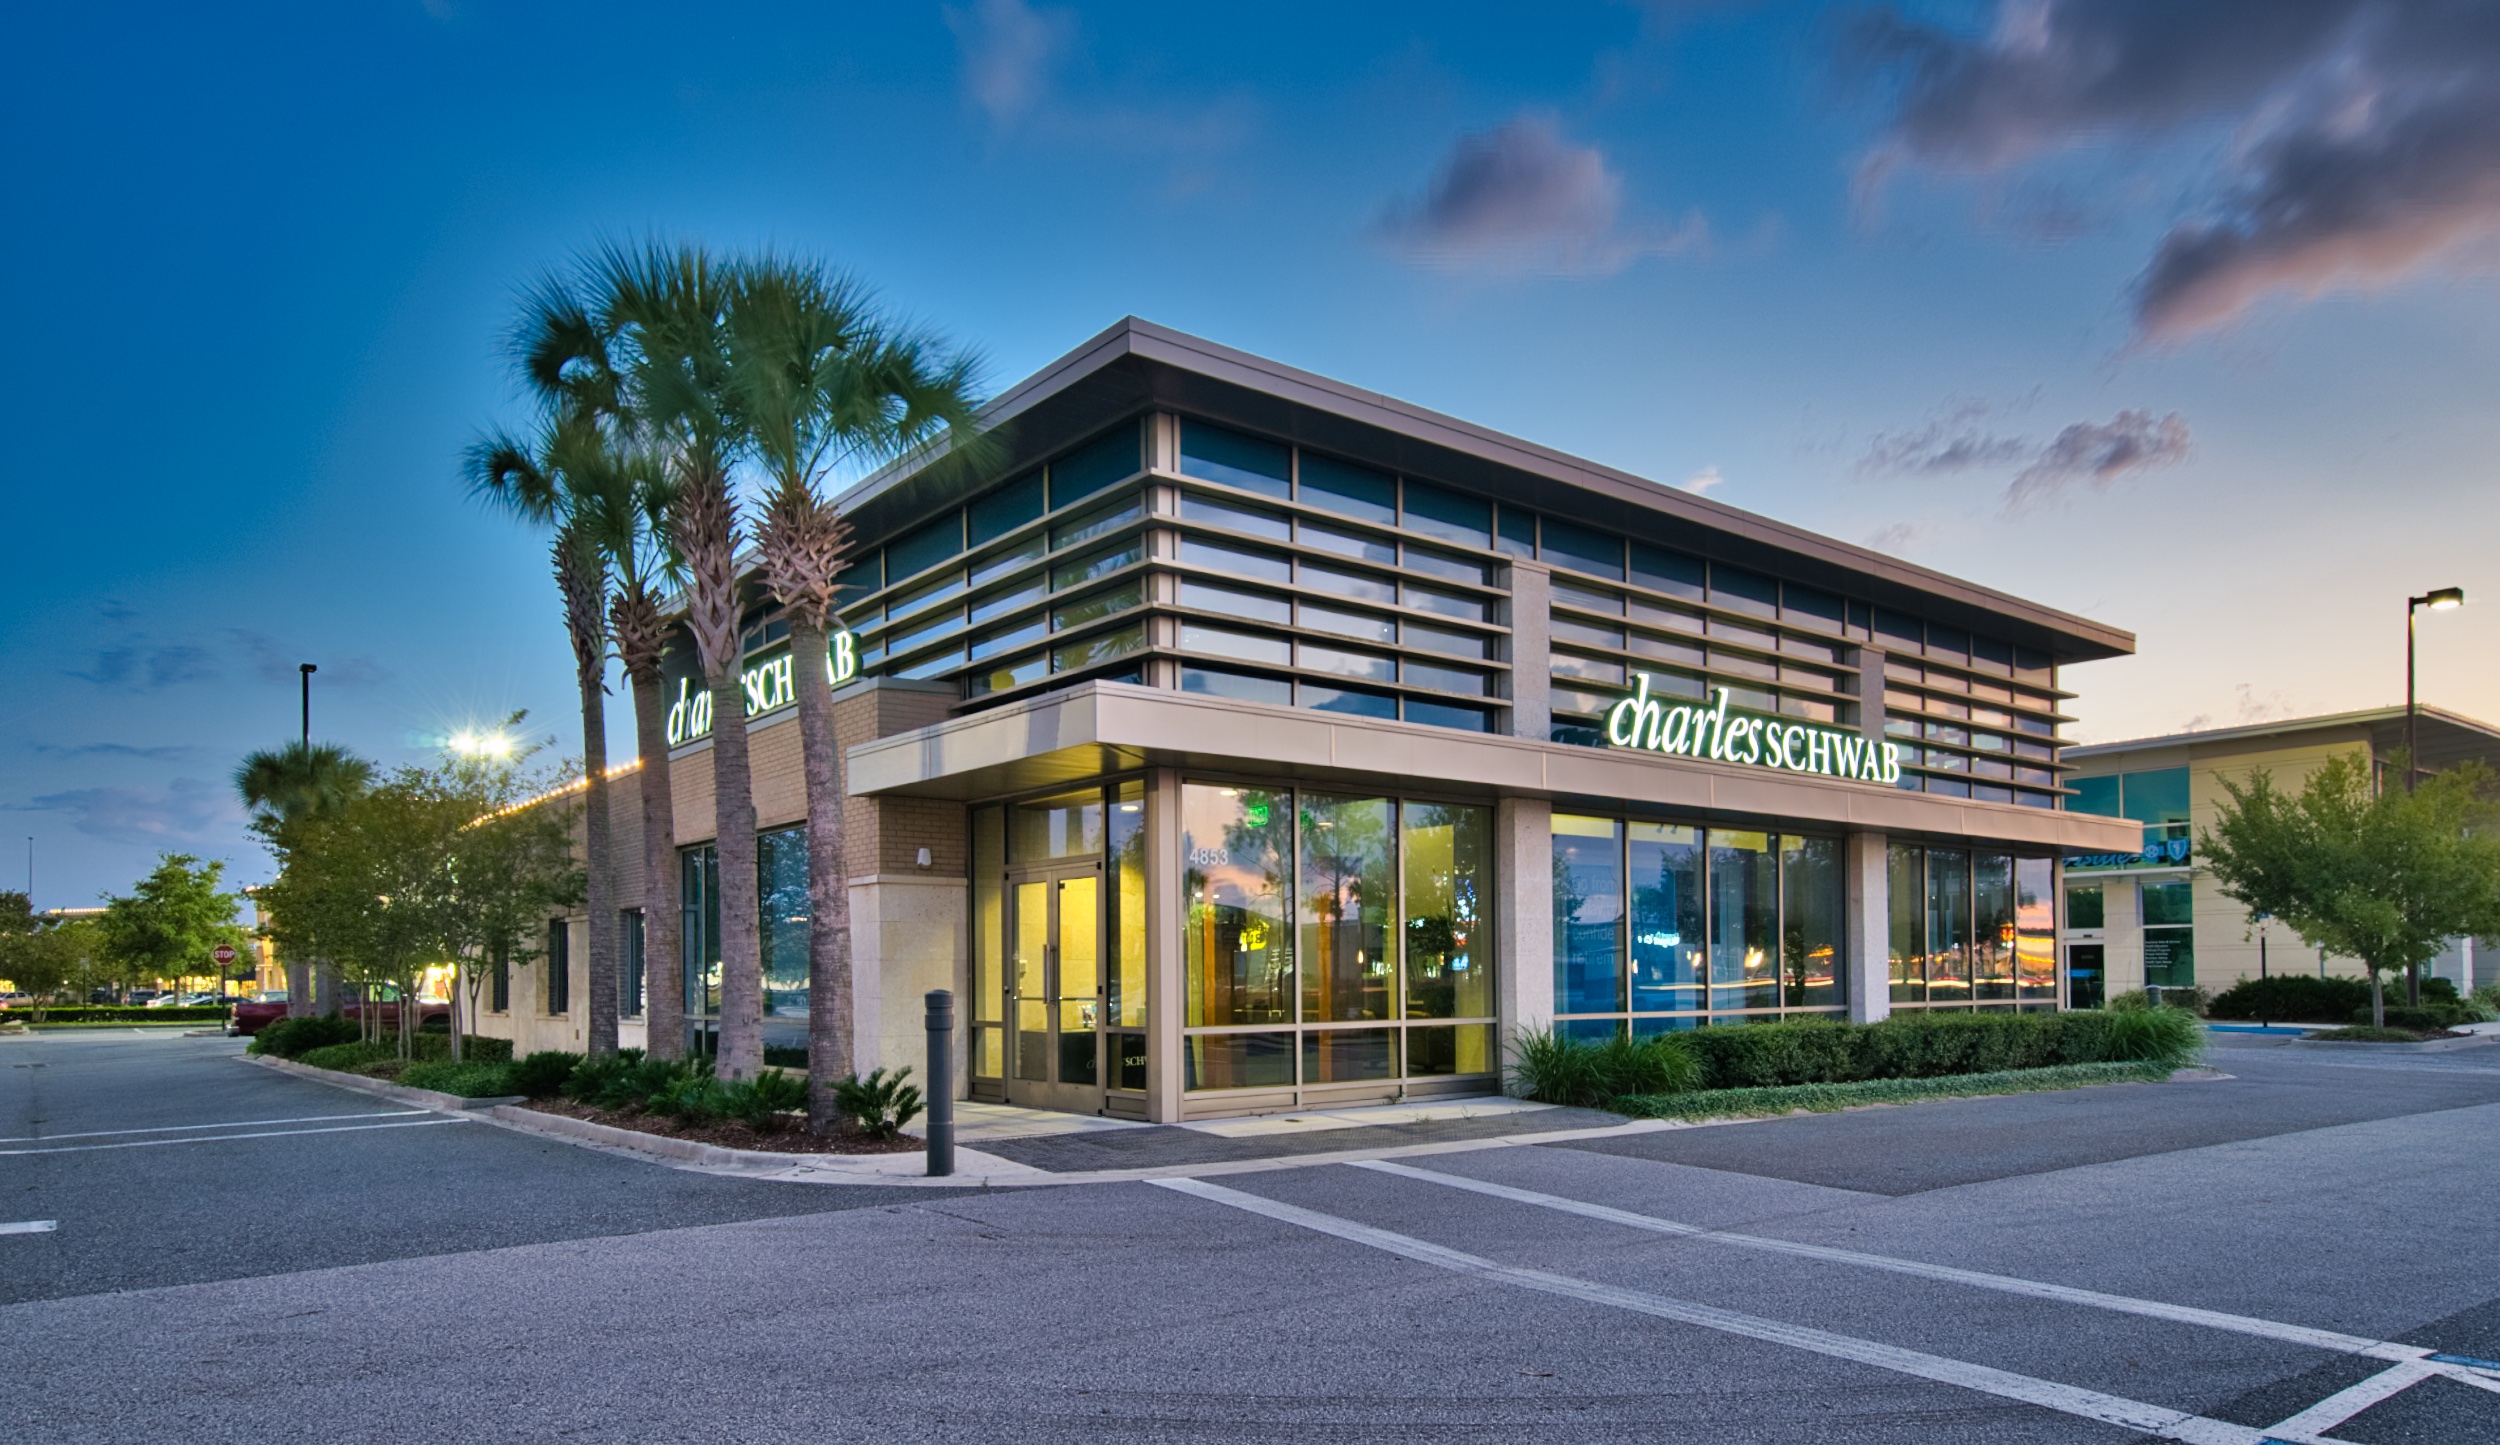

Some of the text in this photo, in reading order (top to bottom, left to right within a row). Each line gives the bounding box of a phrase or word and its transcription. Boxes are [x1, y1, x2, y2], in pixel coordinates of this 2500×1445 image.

[746, 630, 856, 717] SCHB
[1608, 672, 1901, 784] charles SCHWAB
[1189, 848, 1229, 866] 4853
[1572, 925, 1615, 941] confide
[215, 950, 235, 959] STOP
[1572, 950, 1615, 965] retirem
